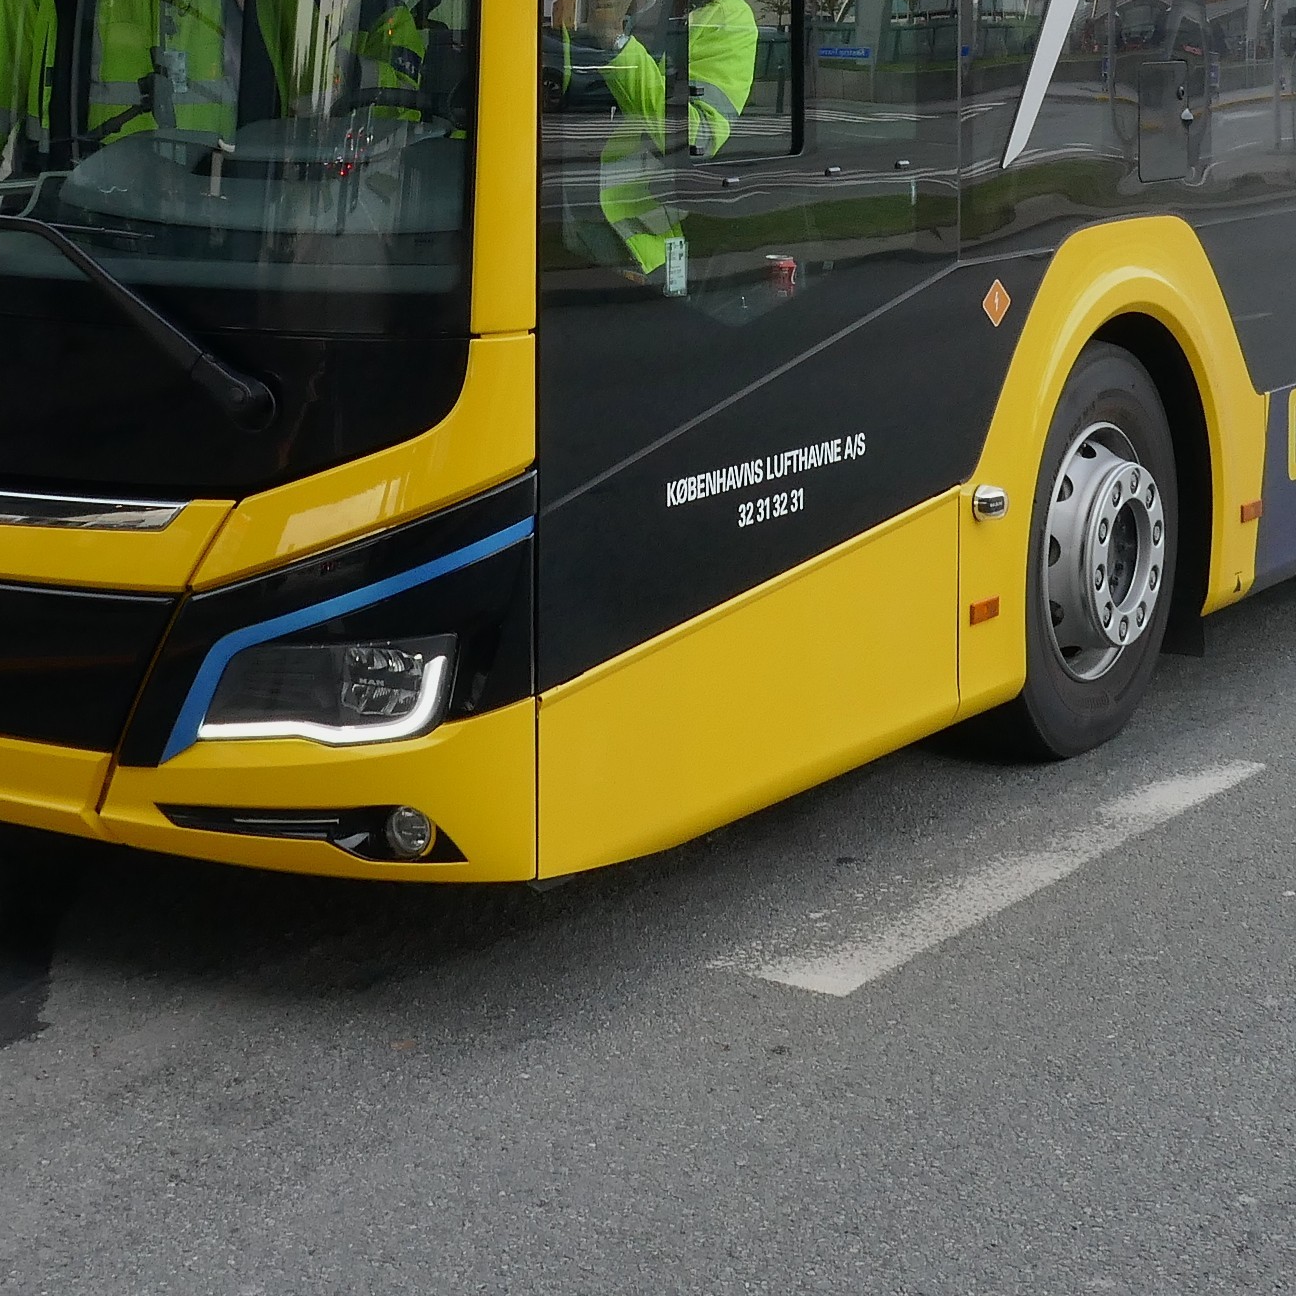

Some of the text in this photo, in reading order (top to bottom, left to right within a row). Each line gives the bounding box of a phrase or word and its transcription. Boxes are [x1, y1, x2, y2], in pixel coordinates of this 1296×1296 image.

[666, 432, 866, 508] KØBENHAVNS LUFTHAVNE A/S
[738, 487, 804, 528] 32 31 32 31
[359, 677, 385, 686] MAN
